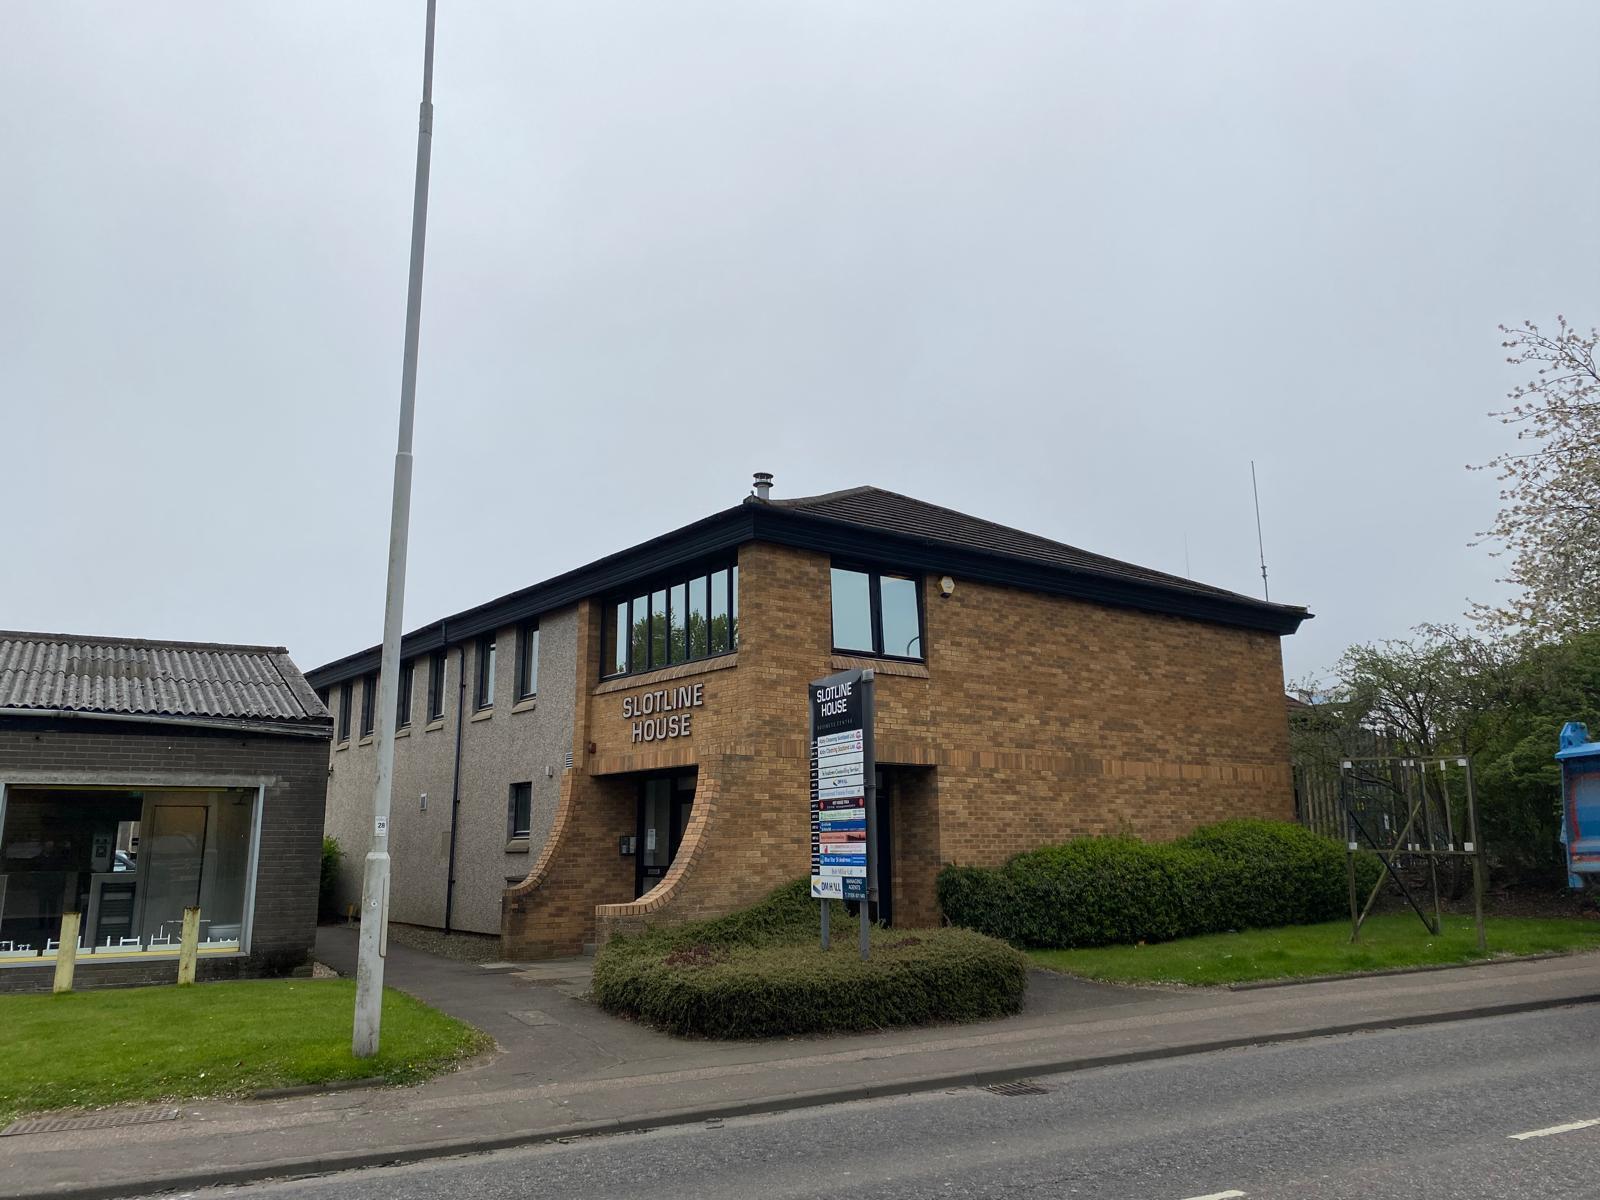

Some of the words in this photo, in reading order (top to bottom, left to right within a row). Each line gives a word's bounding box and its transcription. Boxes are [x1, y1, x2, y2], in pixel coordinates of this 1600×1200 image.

[622, 683, 703, 718] SLOTLINE
[816, 682, 852, 703] SLOTLINE
[821, 699, 847, 717] HOUSE
[632, 713, 691, 743] HOUSE
